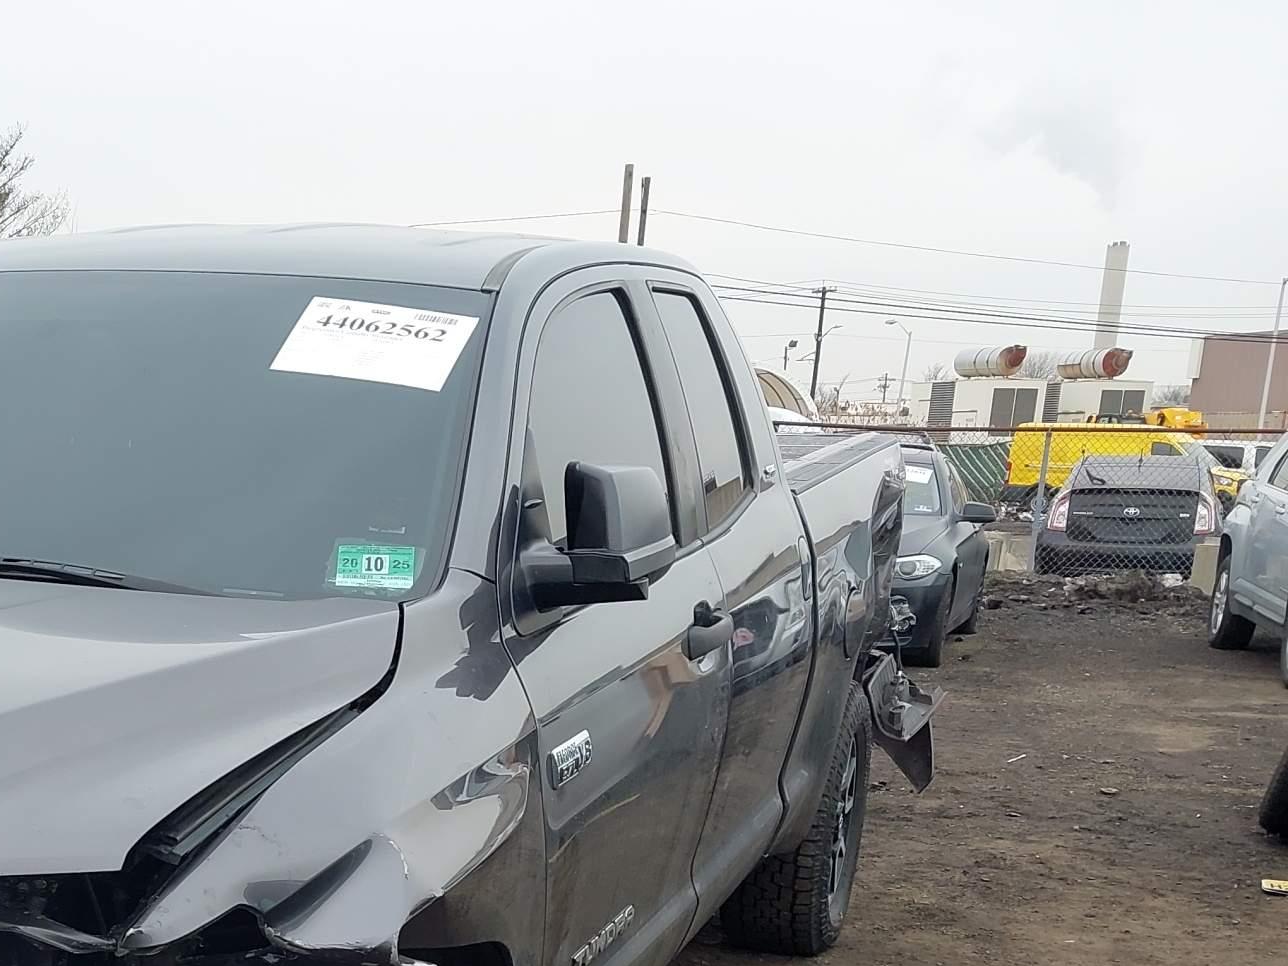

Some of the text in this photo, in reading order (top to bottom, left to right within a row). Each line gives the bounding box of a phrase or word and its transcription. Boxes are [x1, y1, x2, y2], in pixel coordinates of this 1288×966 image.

[316, 313, 448, 343] 44062562
[342, 556, 410, 572] 20 10 25
